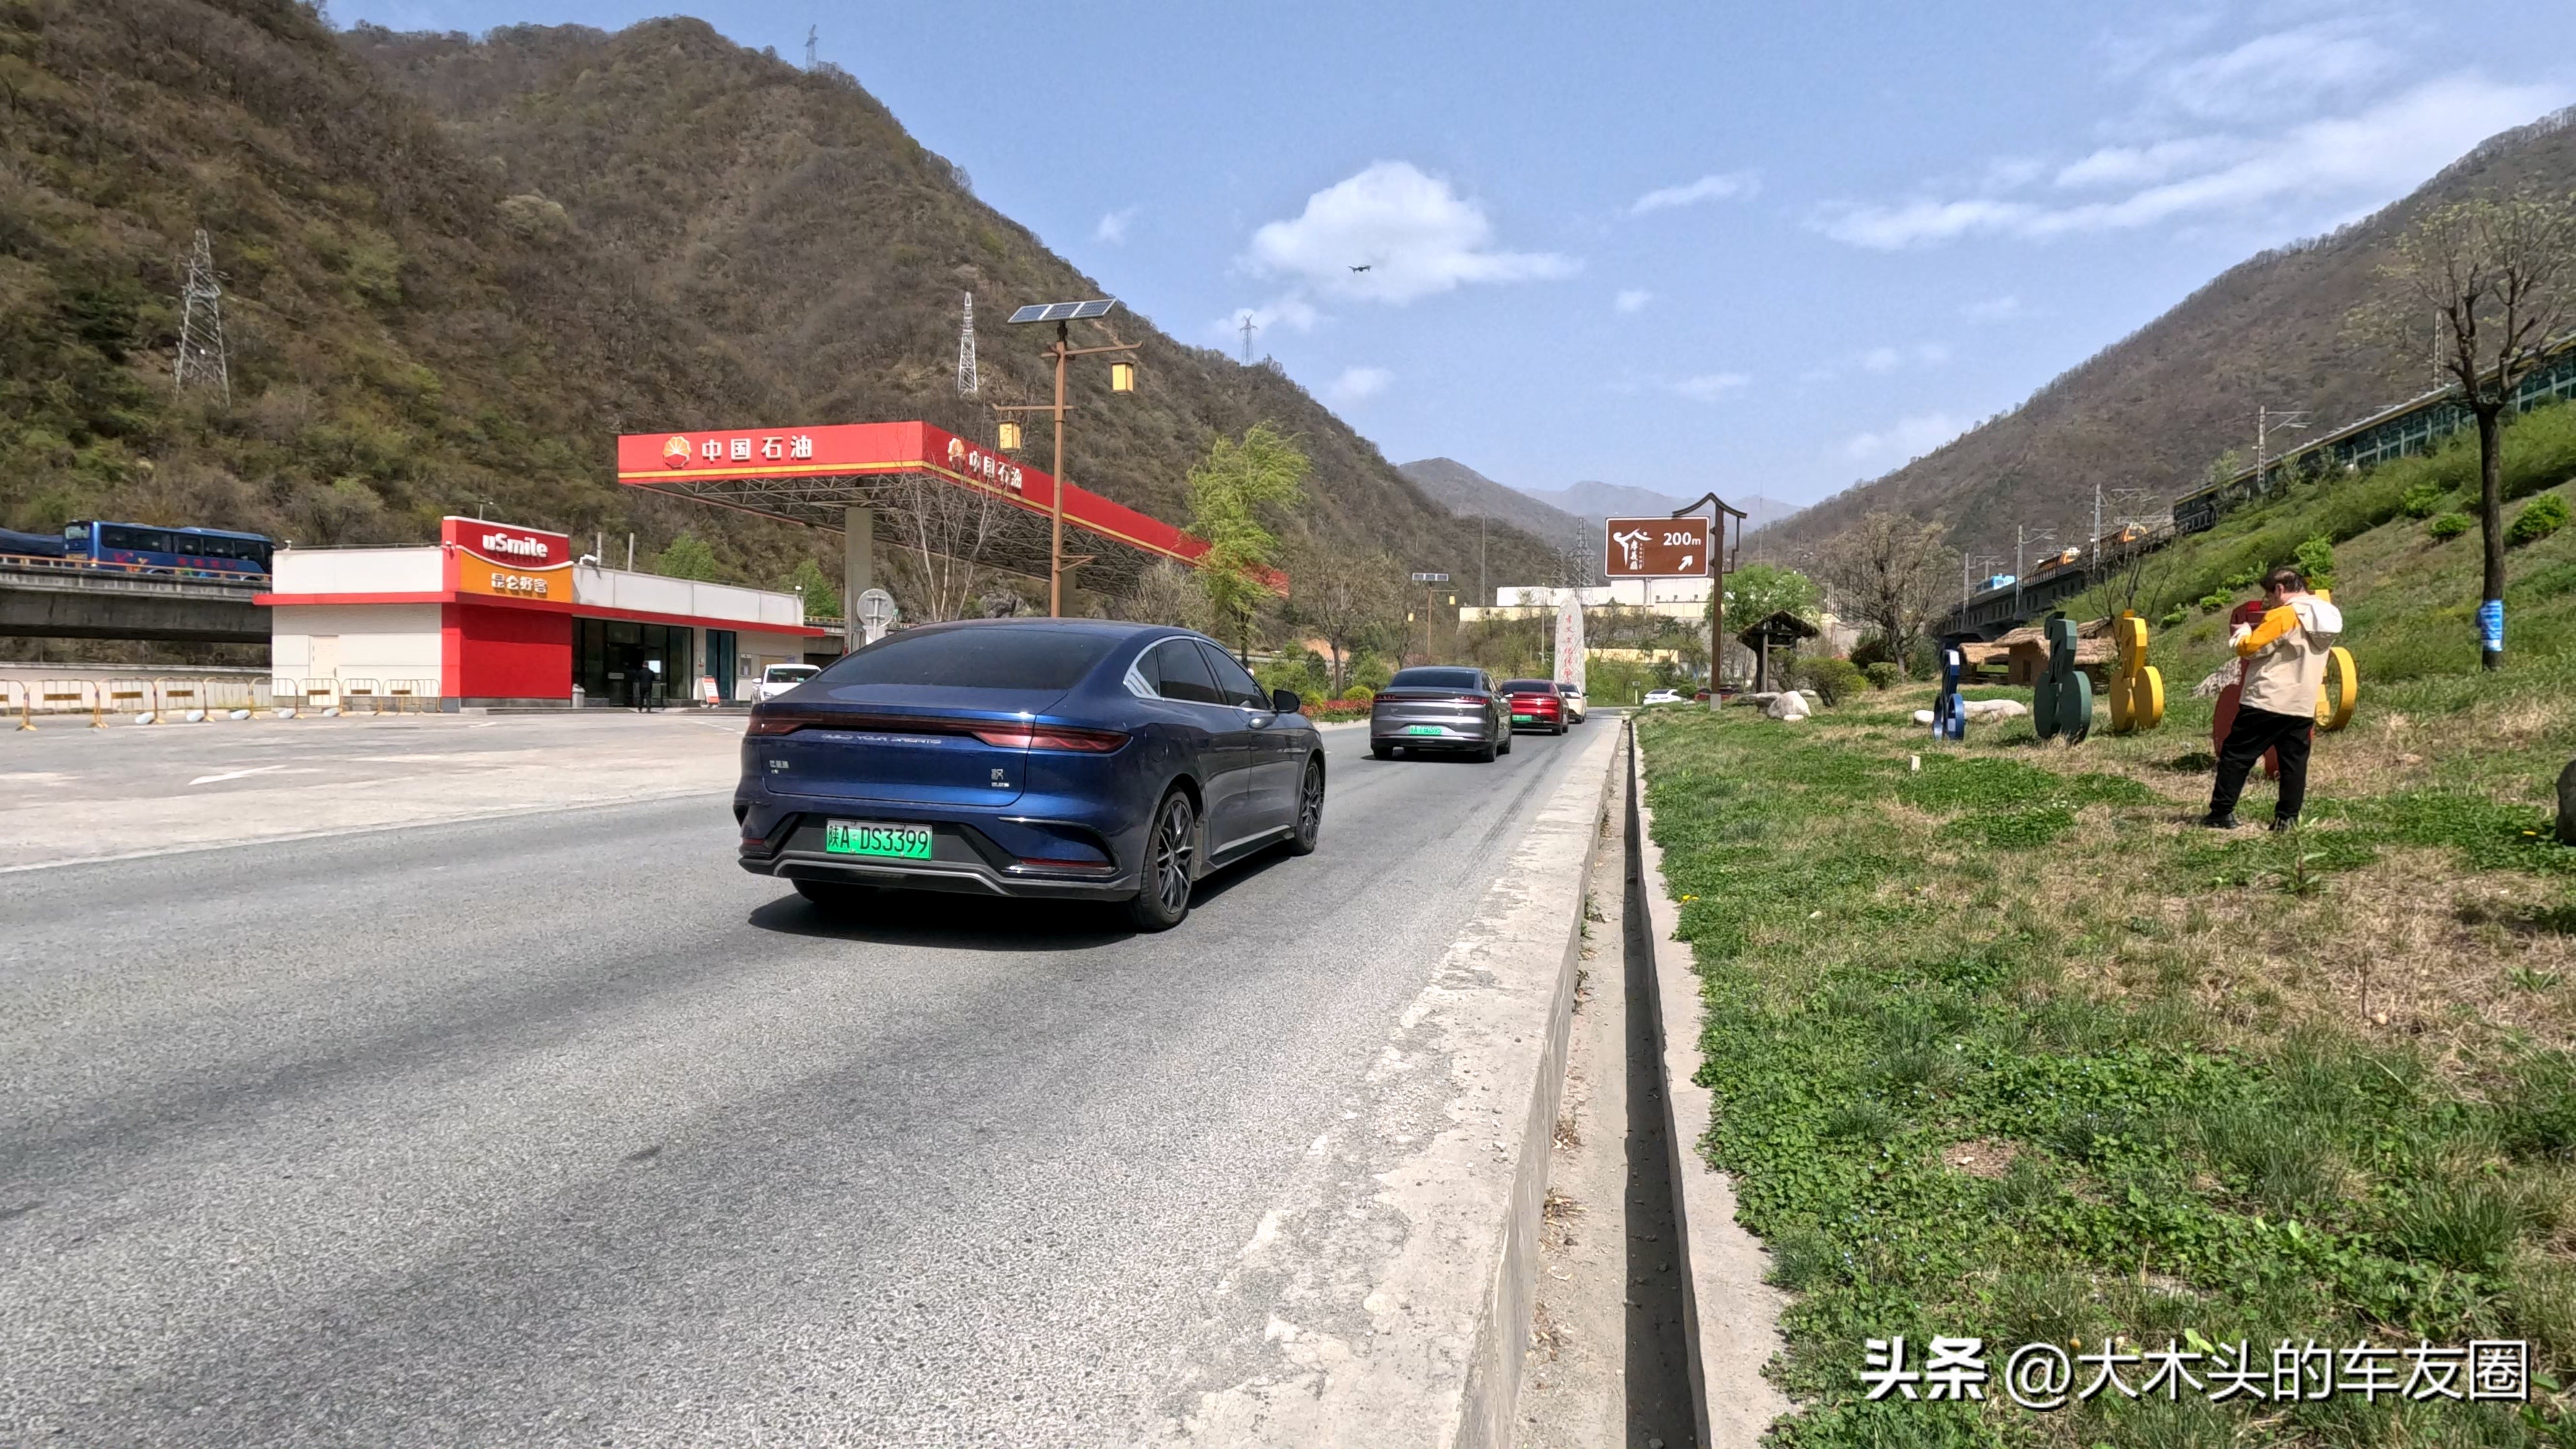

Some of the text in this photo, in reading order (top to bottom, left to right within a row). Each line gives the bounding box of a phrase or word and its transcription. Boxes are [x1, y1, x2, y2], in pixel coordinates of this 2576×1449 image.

[702, 435, 812, 463] 中国石油
[482, 532, 548, 557] uSmile
[1663, 532, 1701, 545] 200m
[491, 572, 548, 593] 昆仑好客
[860, 827, 928, 854] DS3399
